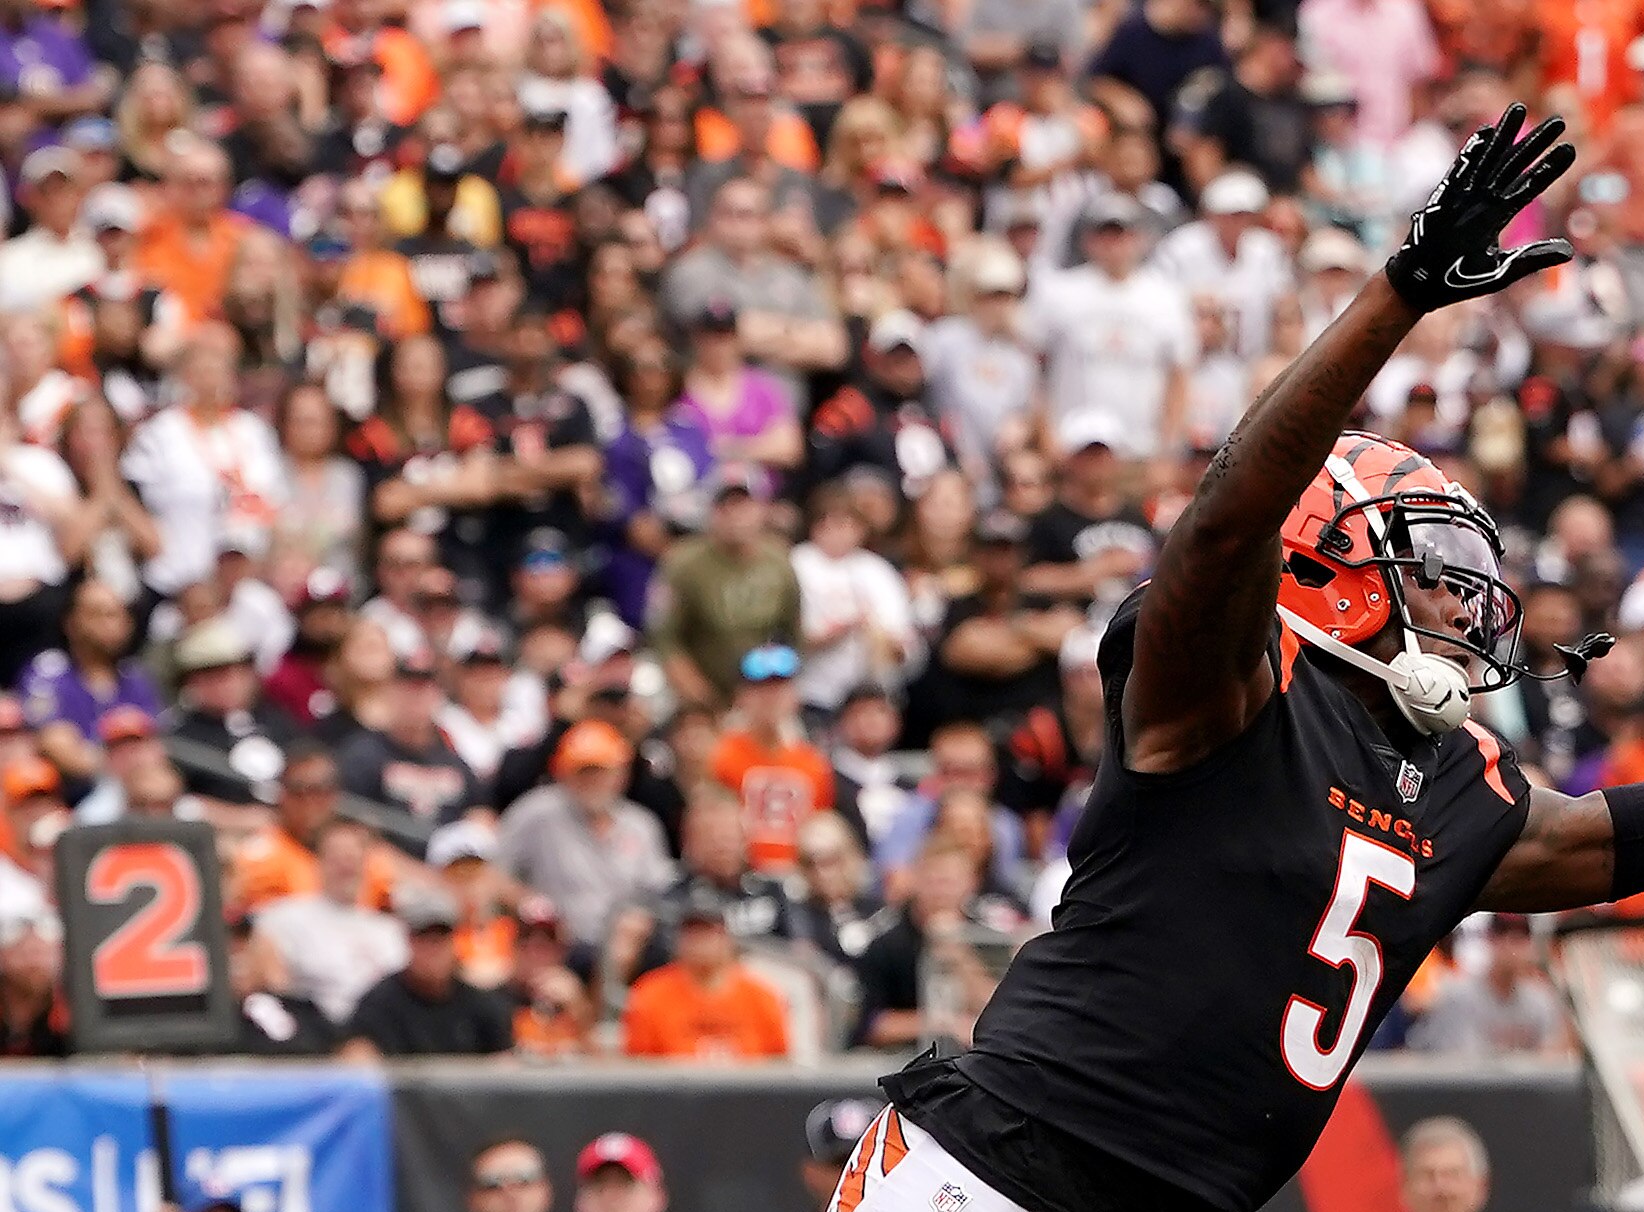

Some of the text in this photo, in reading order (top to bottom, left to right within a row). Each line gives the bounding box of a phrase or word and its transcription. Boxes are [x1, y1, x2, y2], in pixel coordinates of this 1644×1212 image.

[85, 841, 211, 999] 2
[1279, 826, 1416, 1092] 5
[934, 1192, 957, 1212] NFL
